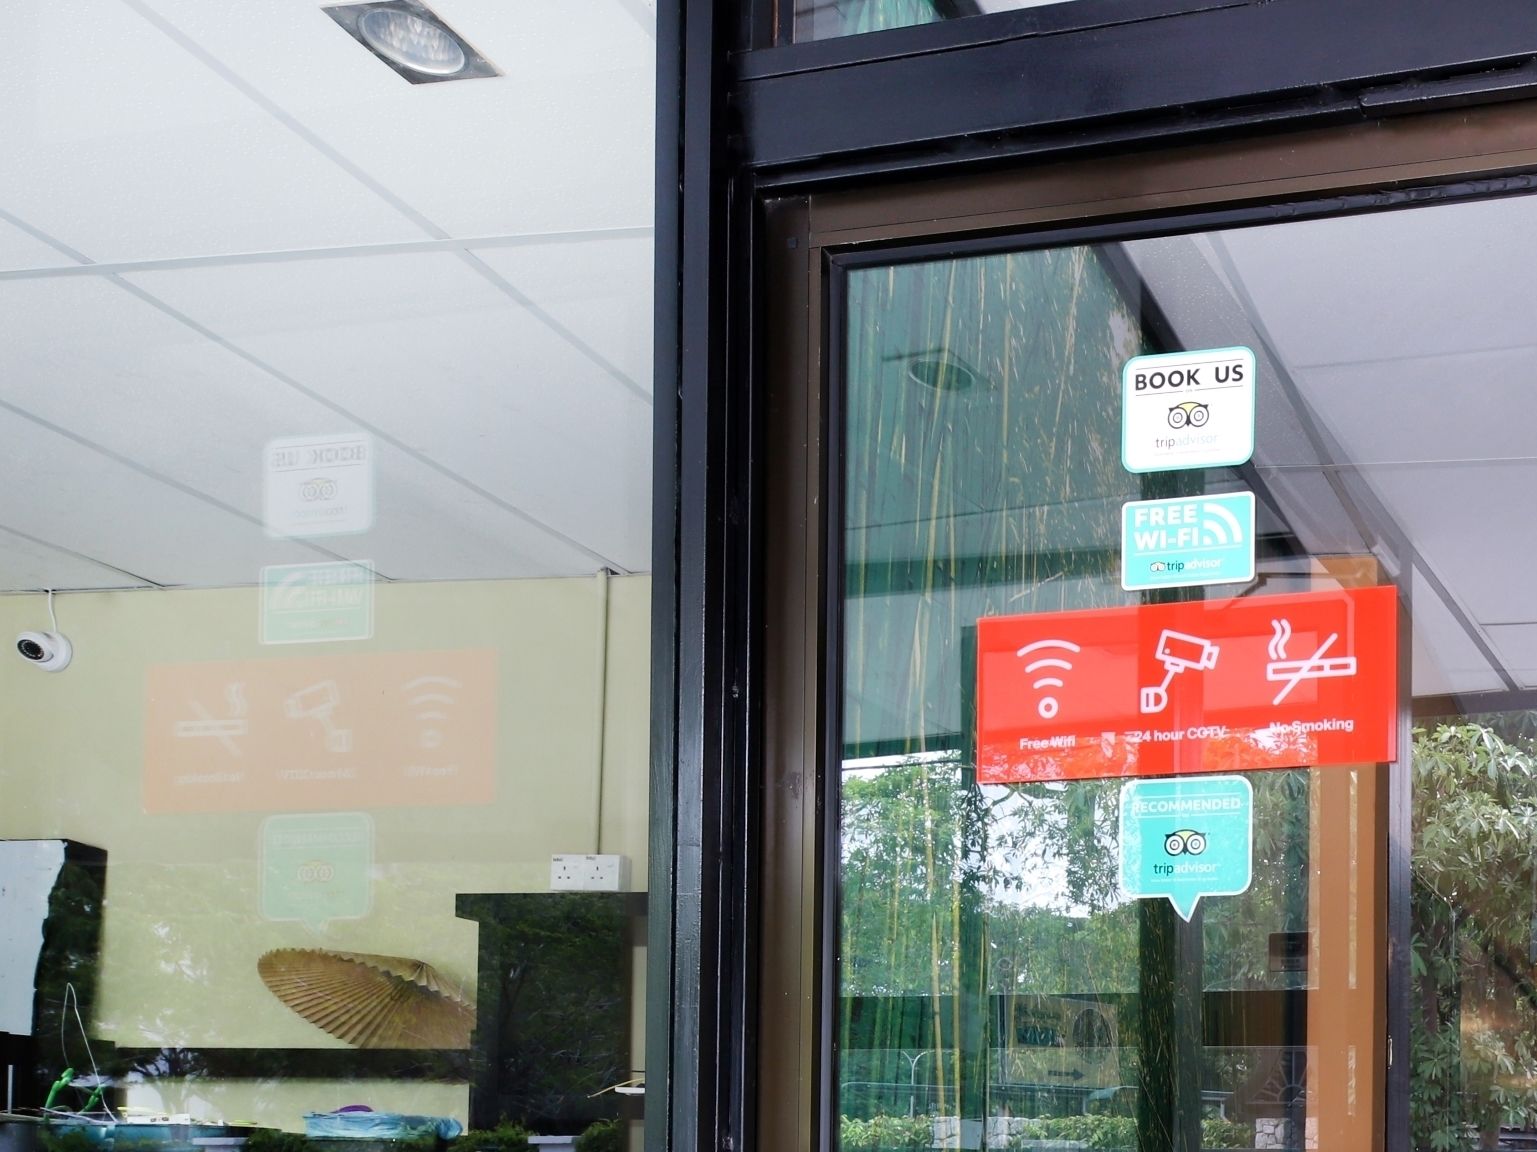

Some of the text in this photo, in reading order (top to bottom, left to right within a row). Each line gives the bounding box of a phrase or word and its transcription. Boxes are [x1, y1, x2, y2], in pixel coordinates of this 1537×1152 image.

[1134, 364, 1244, 391] BOOK US
[1134, 503, 1198, 528] FREE
[1134, 526, 1199, 551] WI-FI
[1134, 725, 1227, 743] 24 hour CCTV
[1291, 717, 1355, 735] Smoking
[1019, 737, 1048, 751] Free
[1131, 797, 1241, 814] RECOMMENDED
[1152, 860, 1217, 877] tripadvisor
